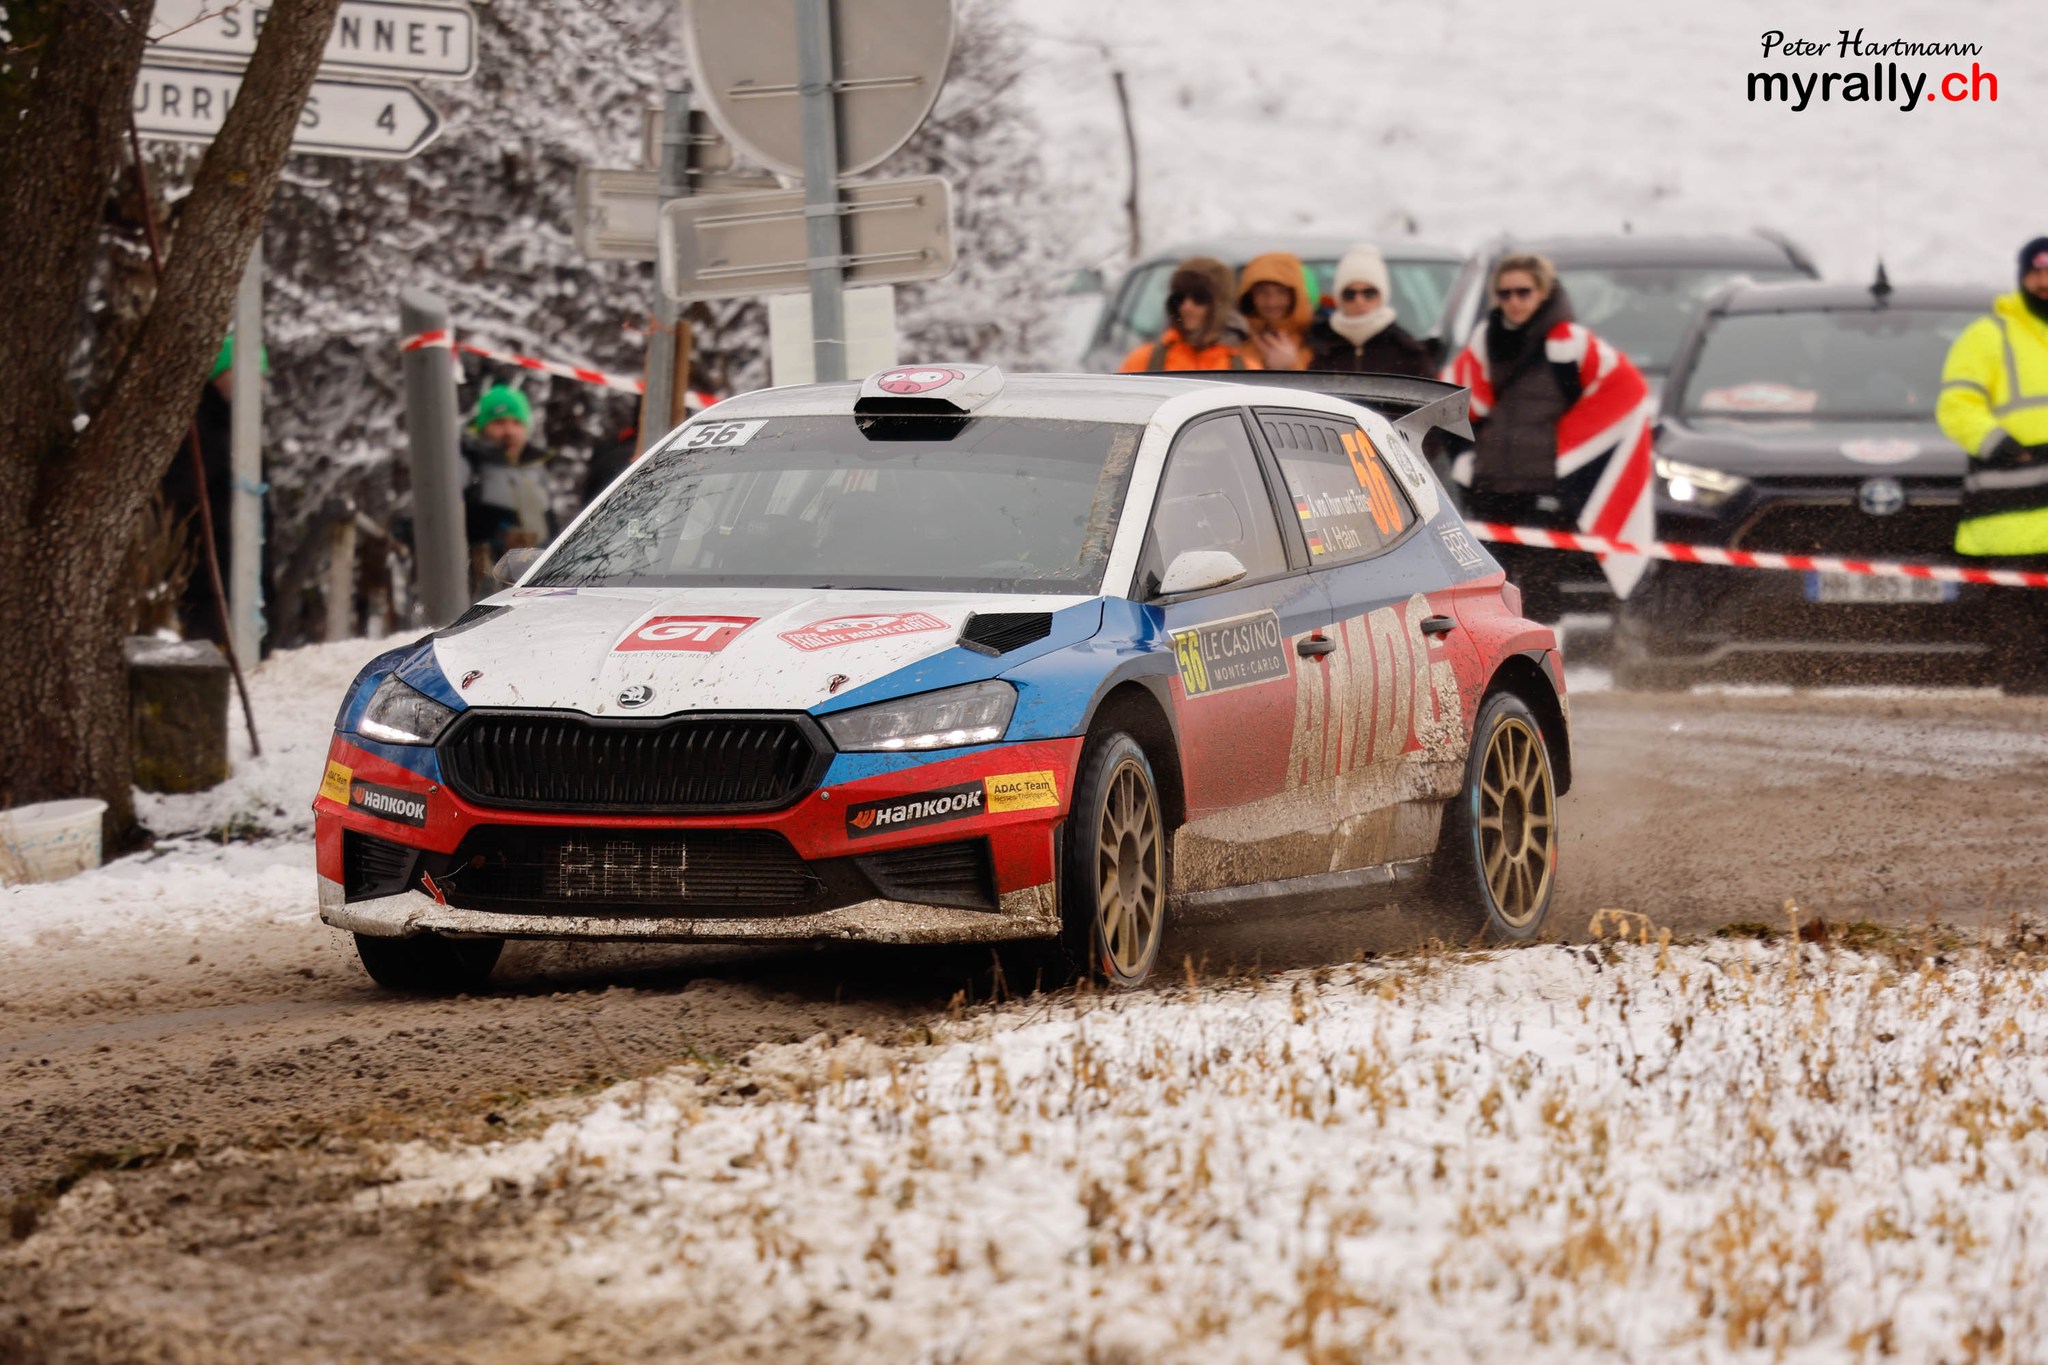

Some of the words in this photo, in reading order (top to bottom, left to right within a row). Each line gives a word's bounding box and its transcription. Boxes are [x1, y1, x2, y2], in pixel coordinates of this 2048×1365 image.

[220, 8, 455, 57] SENNET
[376, 103, 396, 136] 4
[687, 423, 746, 447] 56
[1340, 428, 1403, 535] 56
[1331, 525, 1361, 551] Hain
[1441, 530, 1481, 565] BRR
[637, 621, 747, 642] GT
[797, 631, 849, 650] RALLYE
[1203, 632, 1221, 661] LE
[1221, 619, 1277, 657] CASINO
[1175, 631, 1207, 693] 56
[994, 782, 1022, 794] ADAC
[1024, 781, 1050, 791] Team
